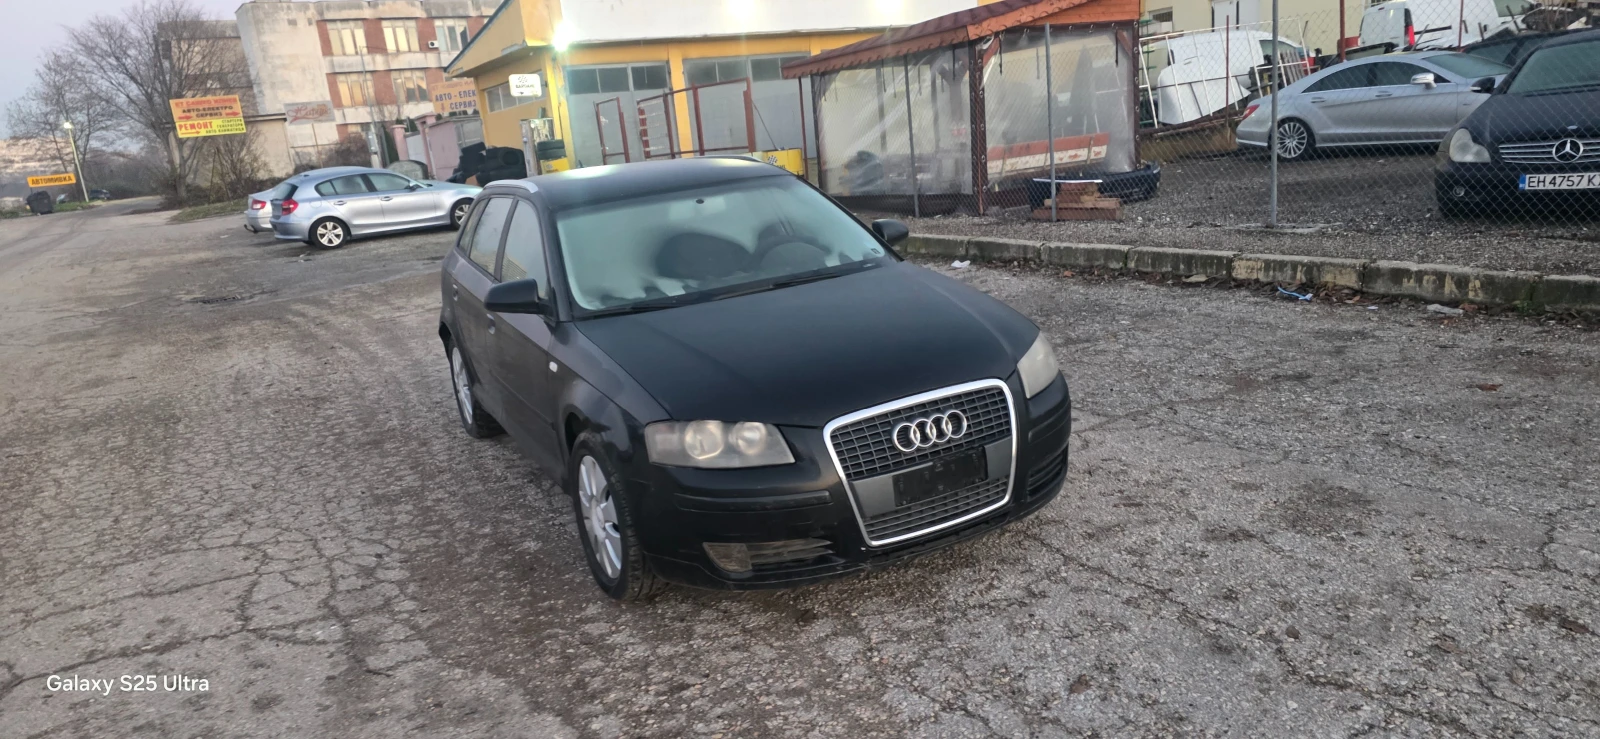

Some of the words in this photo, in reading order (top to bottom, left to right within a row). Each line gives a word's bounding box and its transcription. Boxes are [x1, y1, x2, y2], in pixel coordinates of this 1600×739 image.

[435, 92, 452, 102] АВТО
[182, 105, 233, 113] АВТО-ЕЛЕКТРО
[449, 99, 477, 110] СЕРВИЗ
[178, 121, 213, 131] РЕМОНТ
[31, 175, 73, 185] АВТОМИВКА
[1527, 175, 1547, 188] EH
[1548, 174, 1585, 188] 4757
[1587, 174, 1600, 187] K
